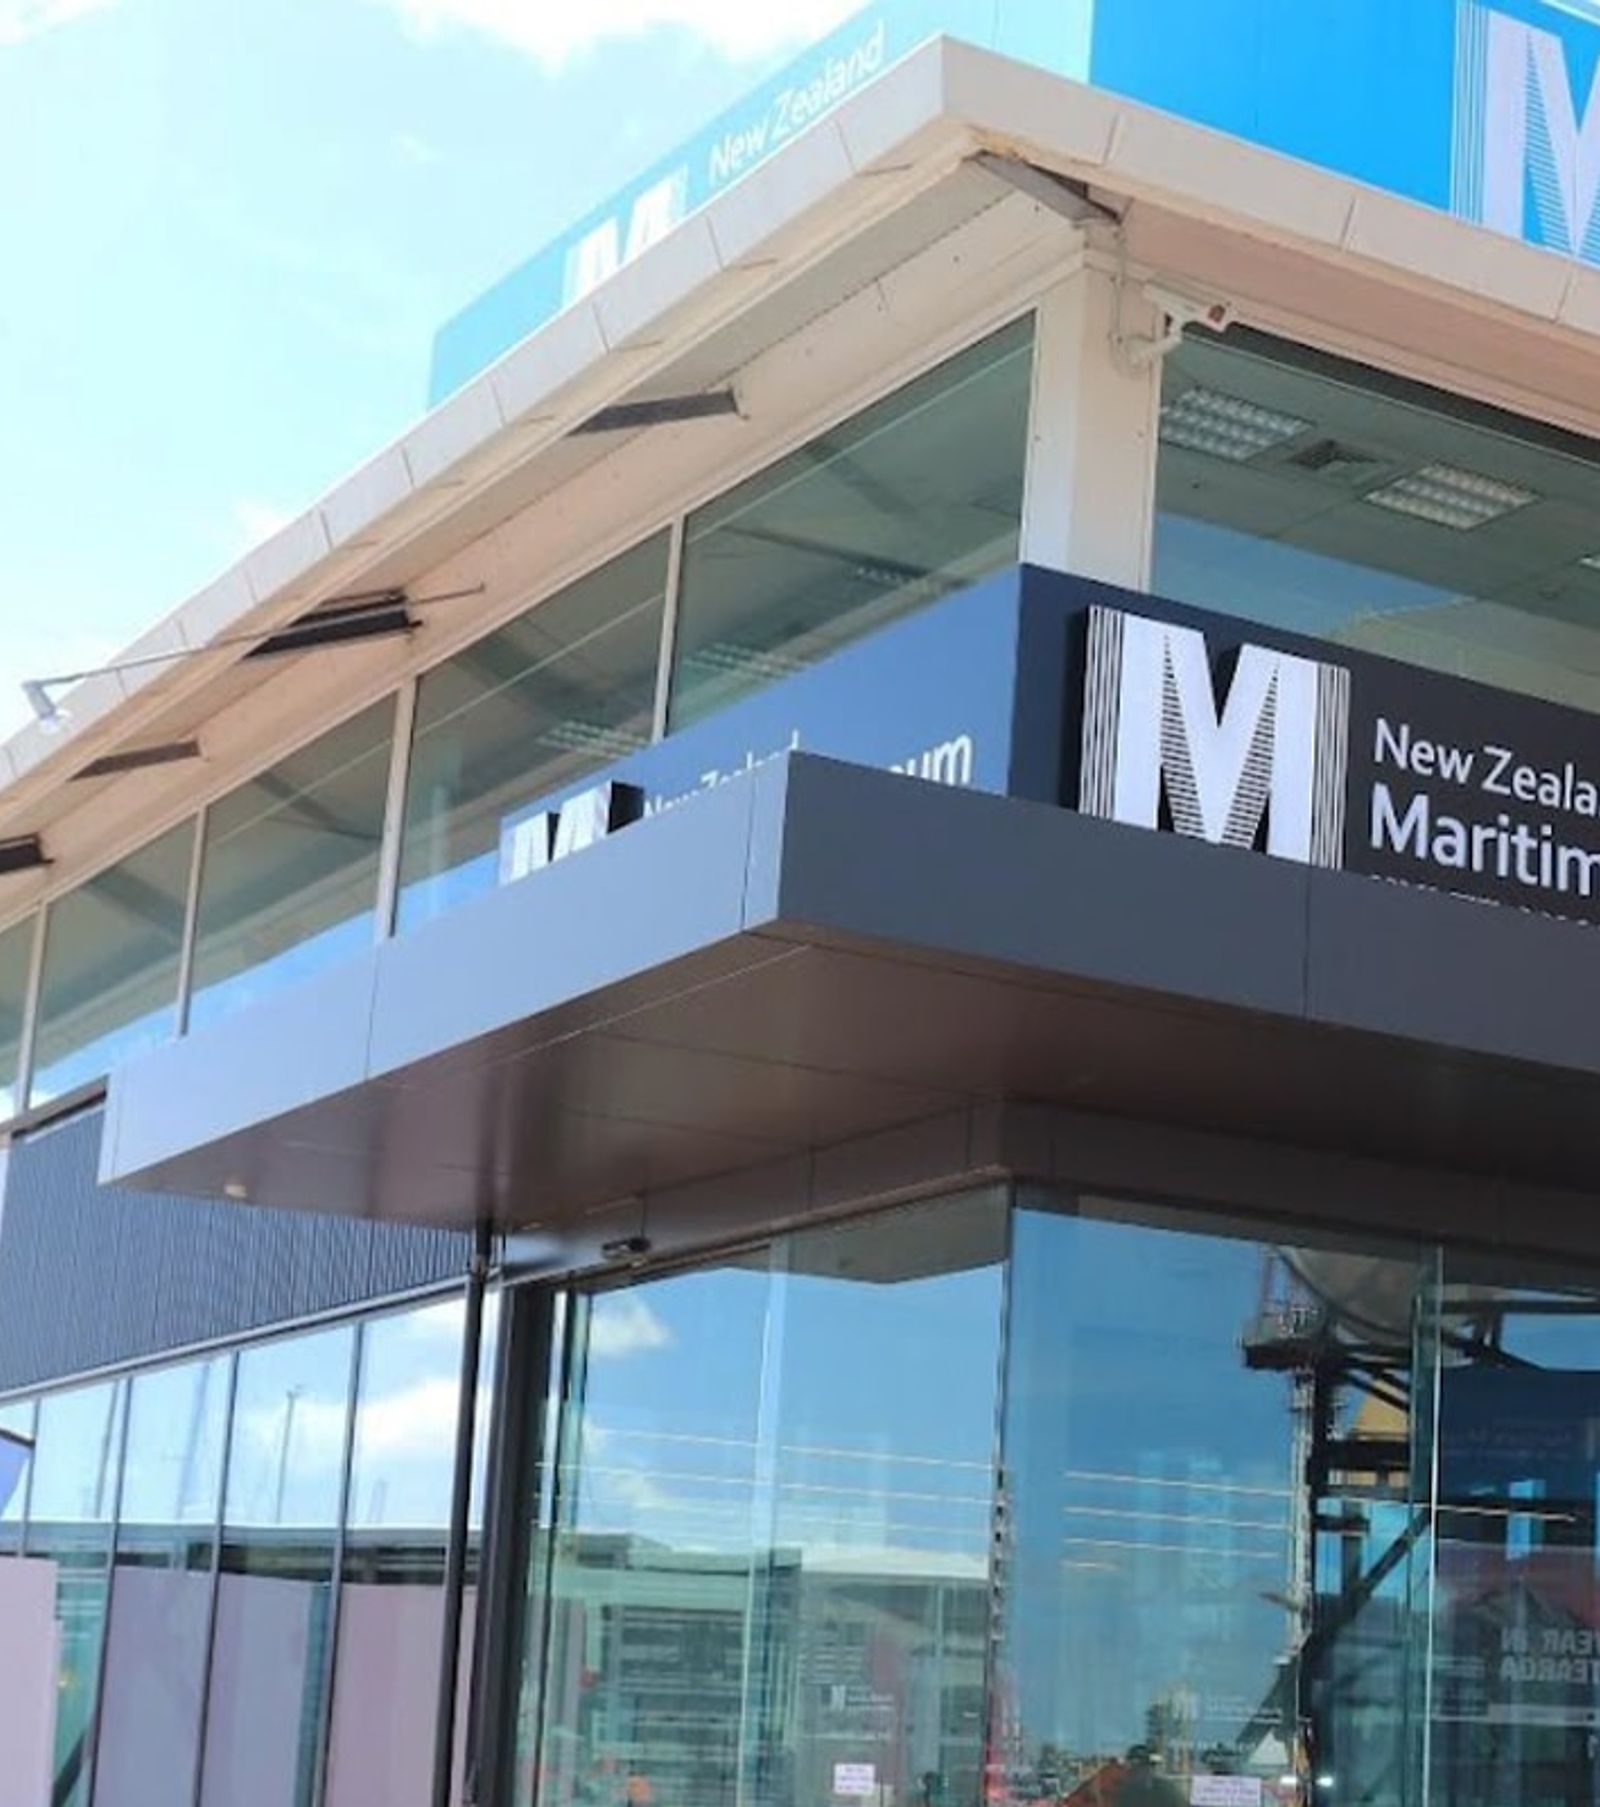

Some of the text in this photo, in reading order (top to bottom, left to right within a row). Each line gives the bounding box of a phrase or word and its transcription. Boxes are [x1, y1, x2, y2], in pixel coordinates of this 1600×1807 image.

[708, 18, 885, 186] New Zealand
[1079, 605, 1350, 868] M
[1374, 718, 1474, 786] New
